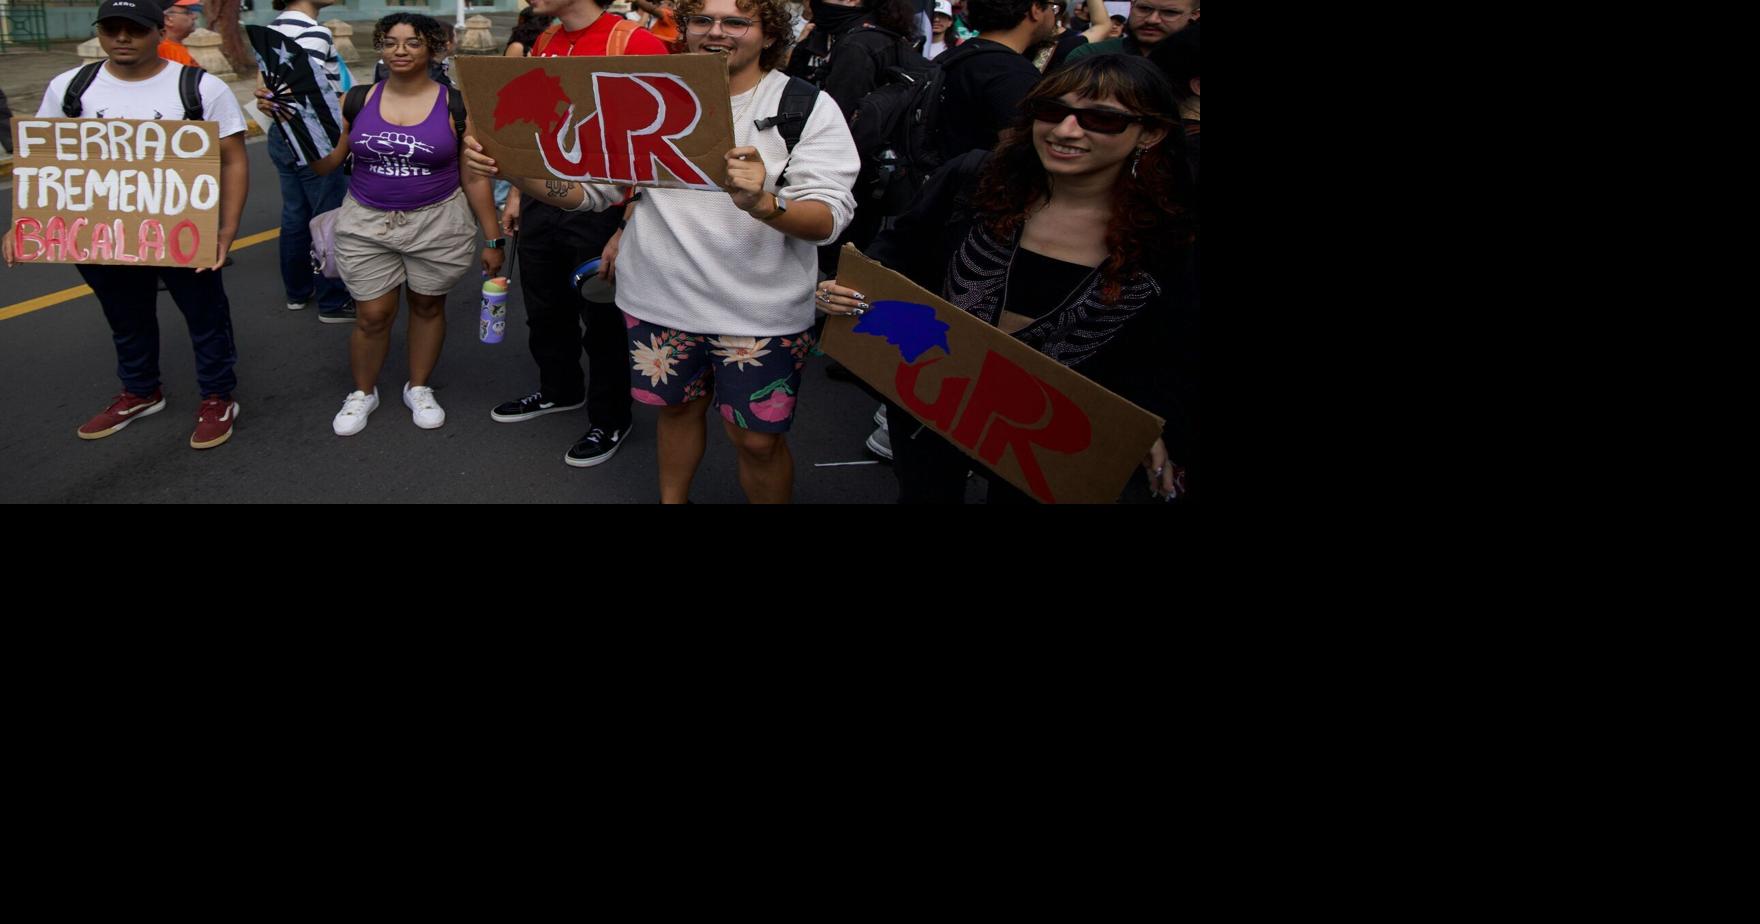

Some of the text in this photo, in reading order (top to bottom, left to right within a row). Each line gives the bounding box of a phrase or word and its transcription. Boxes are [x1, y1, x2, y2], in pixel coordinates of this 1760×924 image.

[18, 121, 210, 162] FERRAO
[13, 166, 219, 215] TREMENDO
[369, 164, 432, 176] RESISTE
[14, 216, 200, 265] BACALAO
